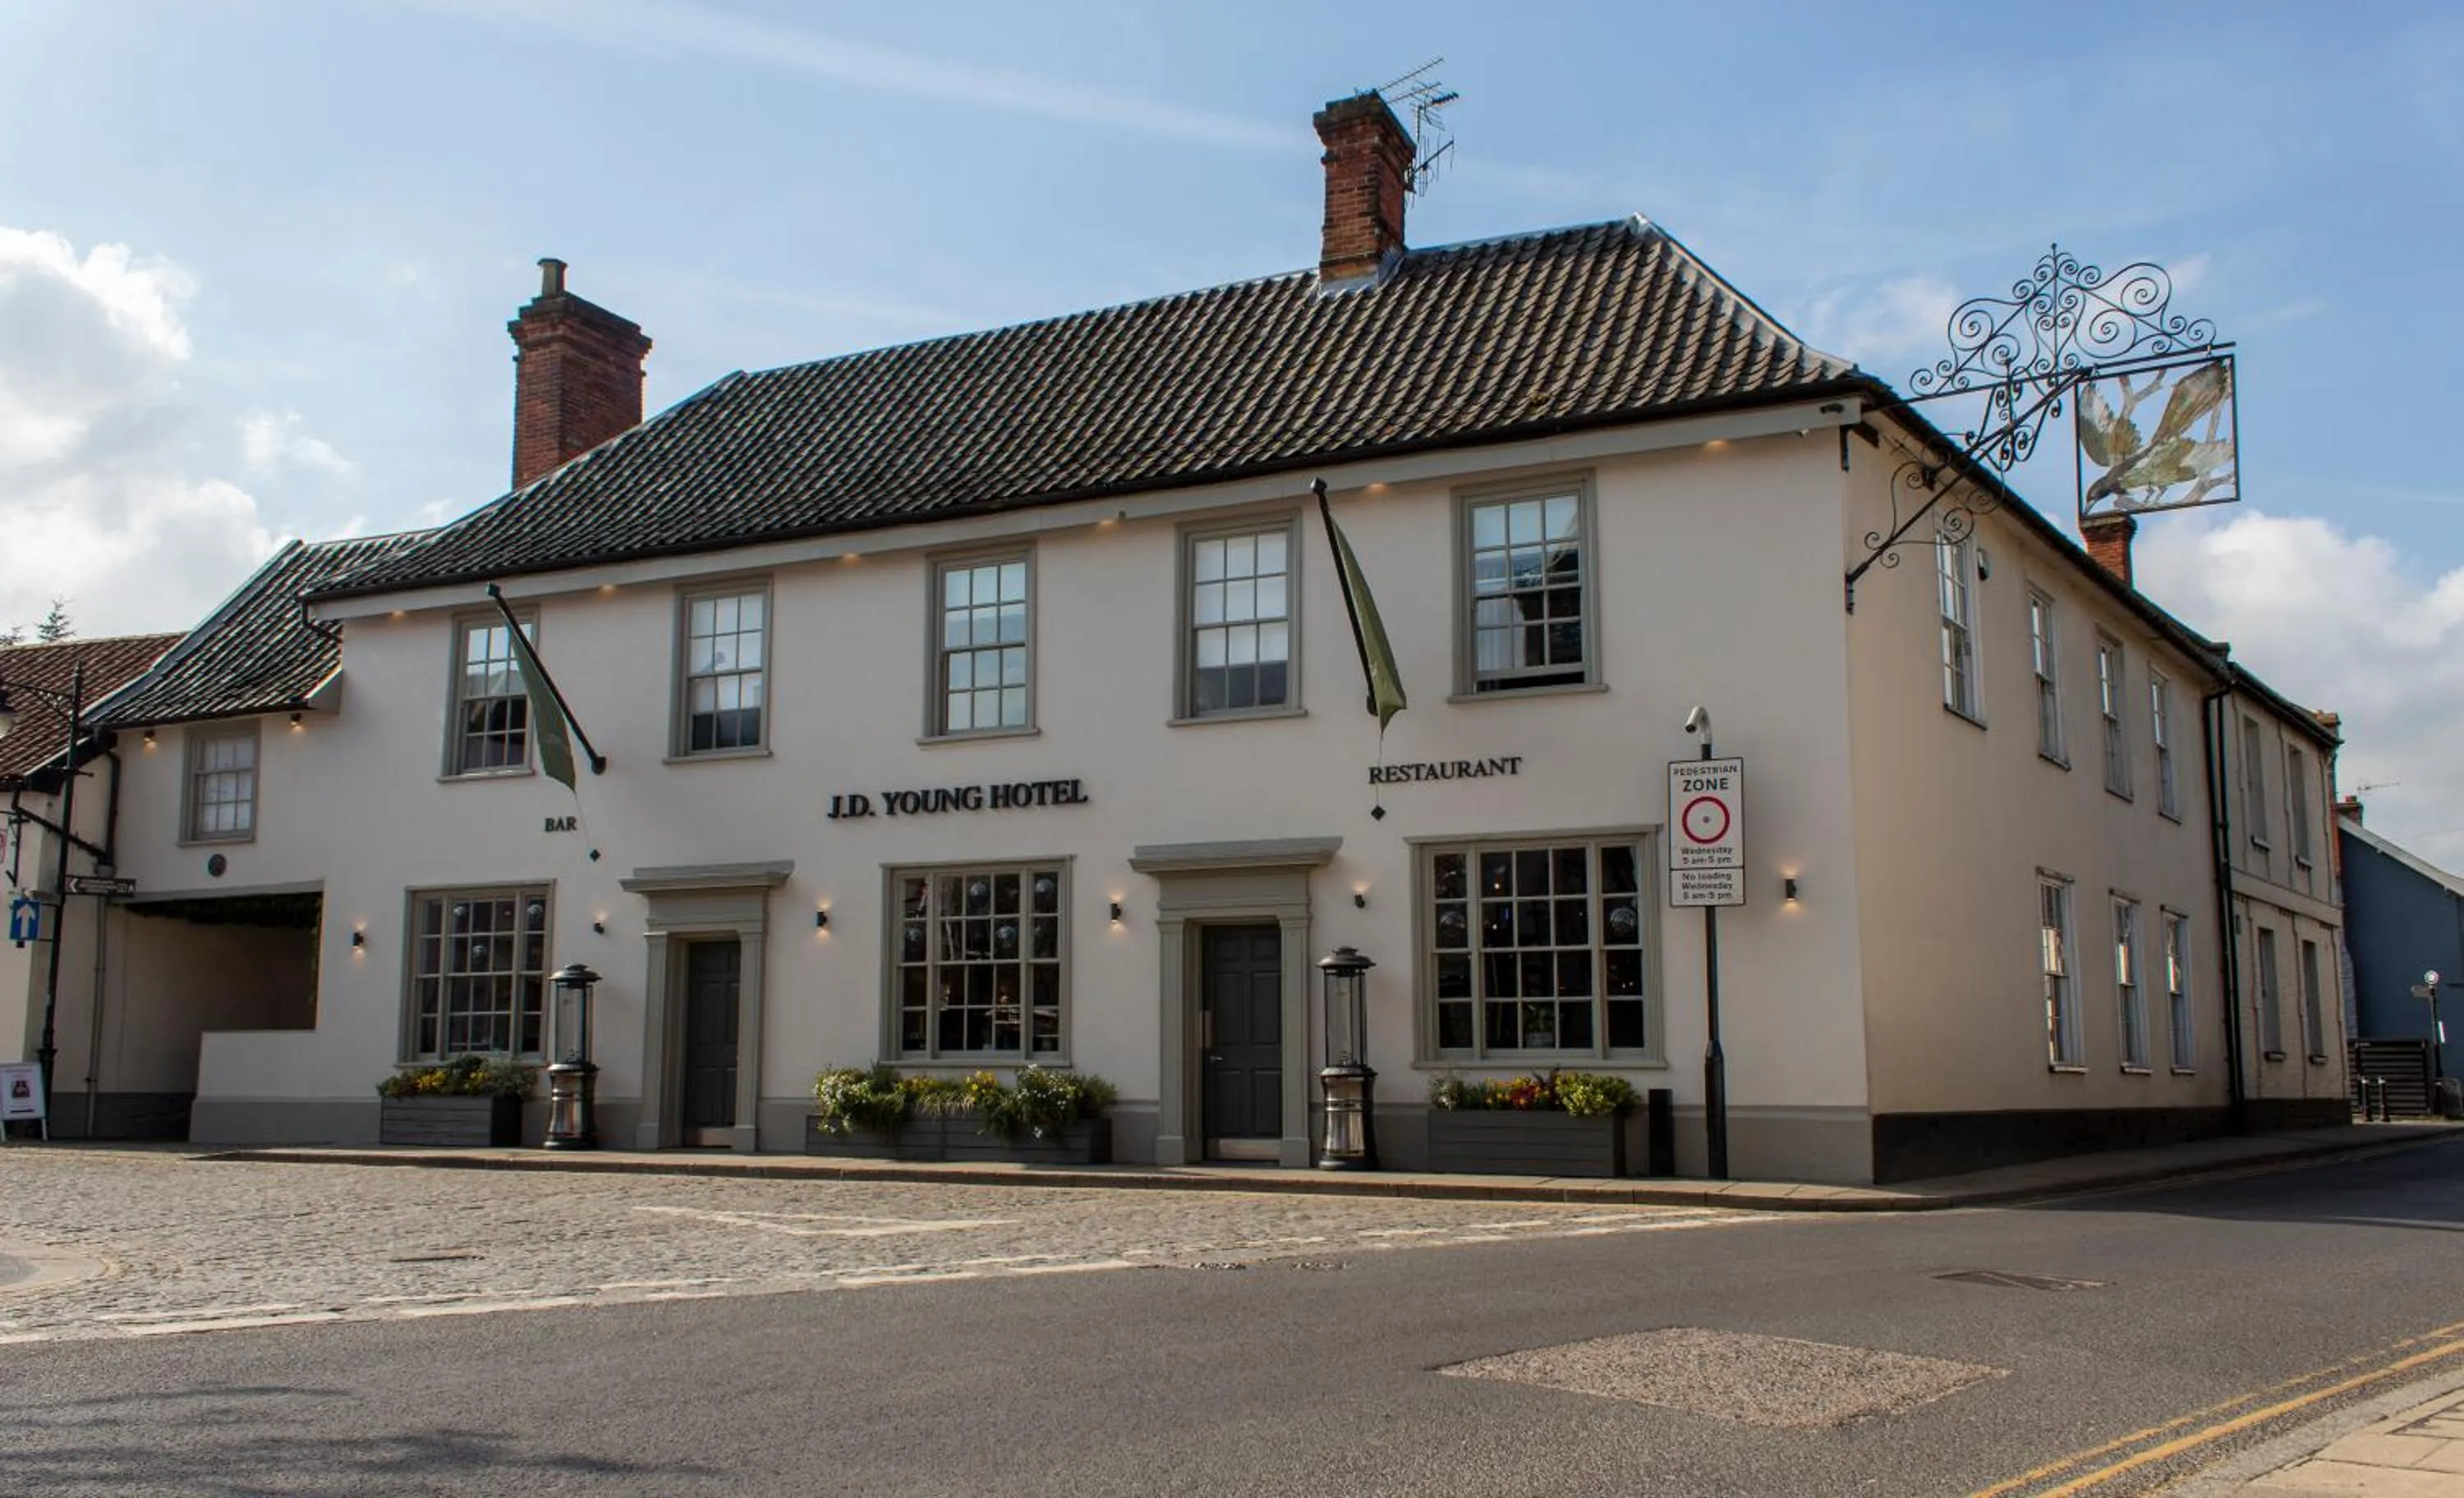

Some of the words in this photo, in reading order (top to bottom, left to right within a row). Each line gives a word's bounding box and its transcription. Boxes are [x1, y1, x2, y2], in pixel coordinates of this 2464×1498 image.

[1368, 757, 1522, 784] RESTAURANT
[1673, 765, 1737, 775] PEDESTRIAN
[1683, 778, 1728, 792] ZONE
[828, 794, 876, 819] J.D.
[881, 786, 983, 816] YOUNG
[989, 779, 1088, 809] HOTEL
[545, 816, 577, 832] BAR
[1681, 847, 1733, 855] Wednesday
[1698, 871, 1732, 881] loading
[1681, 882, 1733, 890] Wednesday
